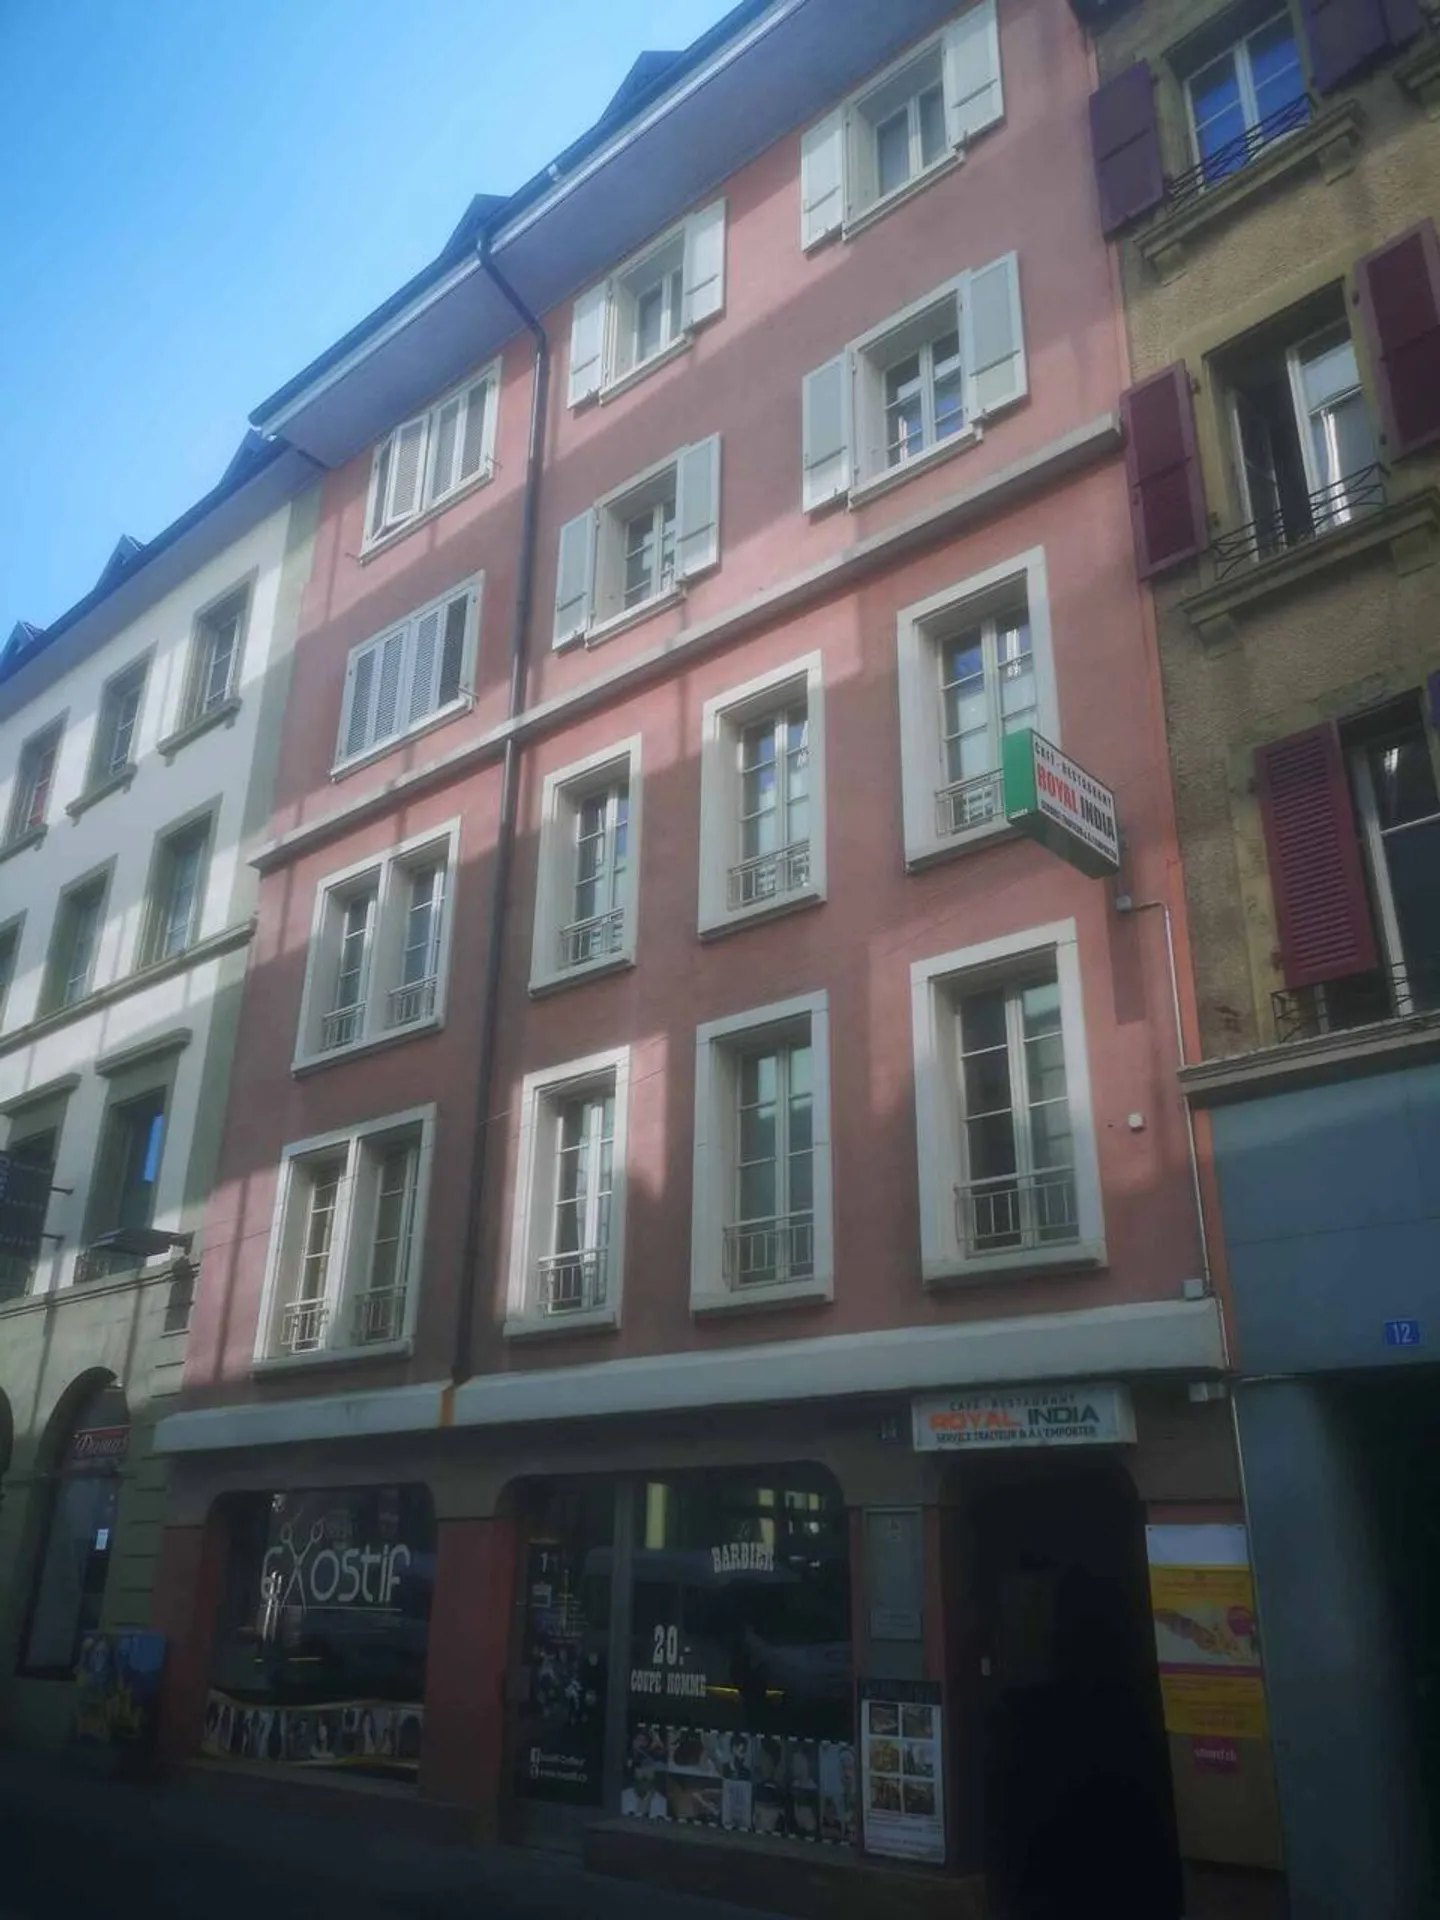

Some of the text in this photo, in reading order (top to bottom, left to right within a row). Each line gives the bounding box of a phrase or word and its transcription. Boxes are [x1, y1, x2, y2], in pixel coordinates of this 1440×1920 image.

[1037, 762, 1077, 815] ROYAL
[1080, 795, 1116, 843] INDIA
[1392, 1322, 1413, 1344] 12
[929, 1404, 1100, 1431] ROYAL INDIA
[711, 1542, 775, 1574] BARBIER
[652, 1623, 692, 1666] 20.-
[630, 1669, 707, 1698] COUPE HOMME
